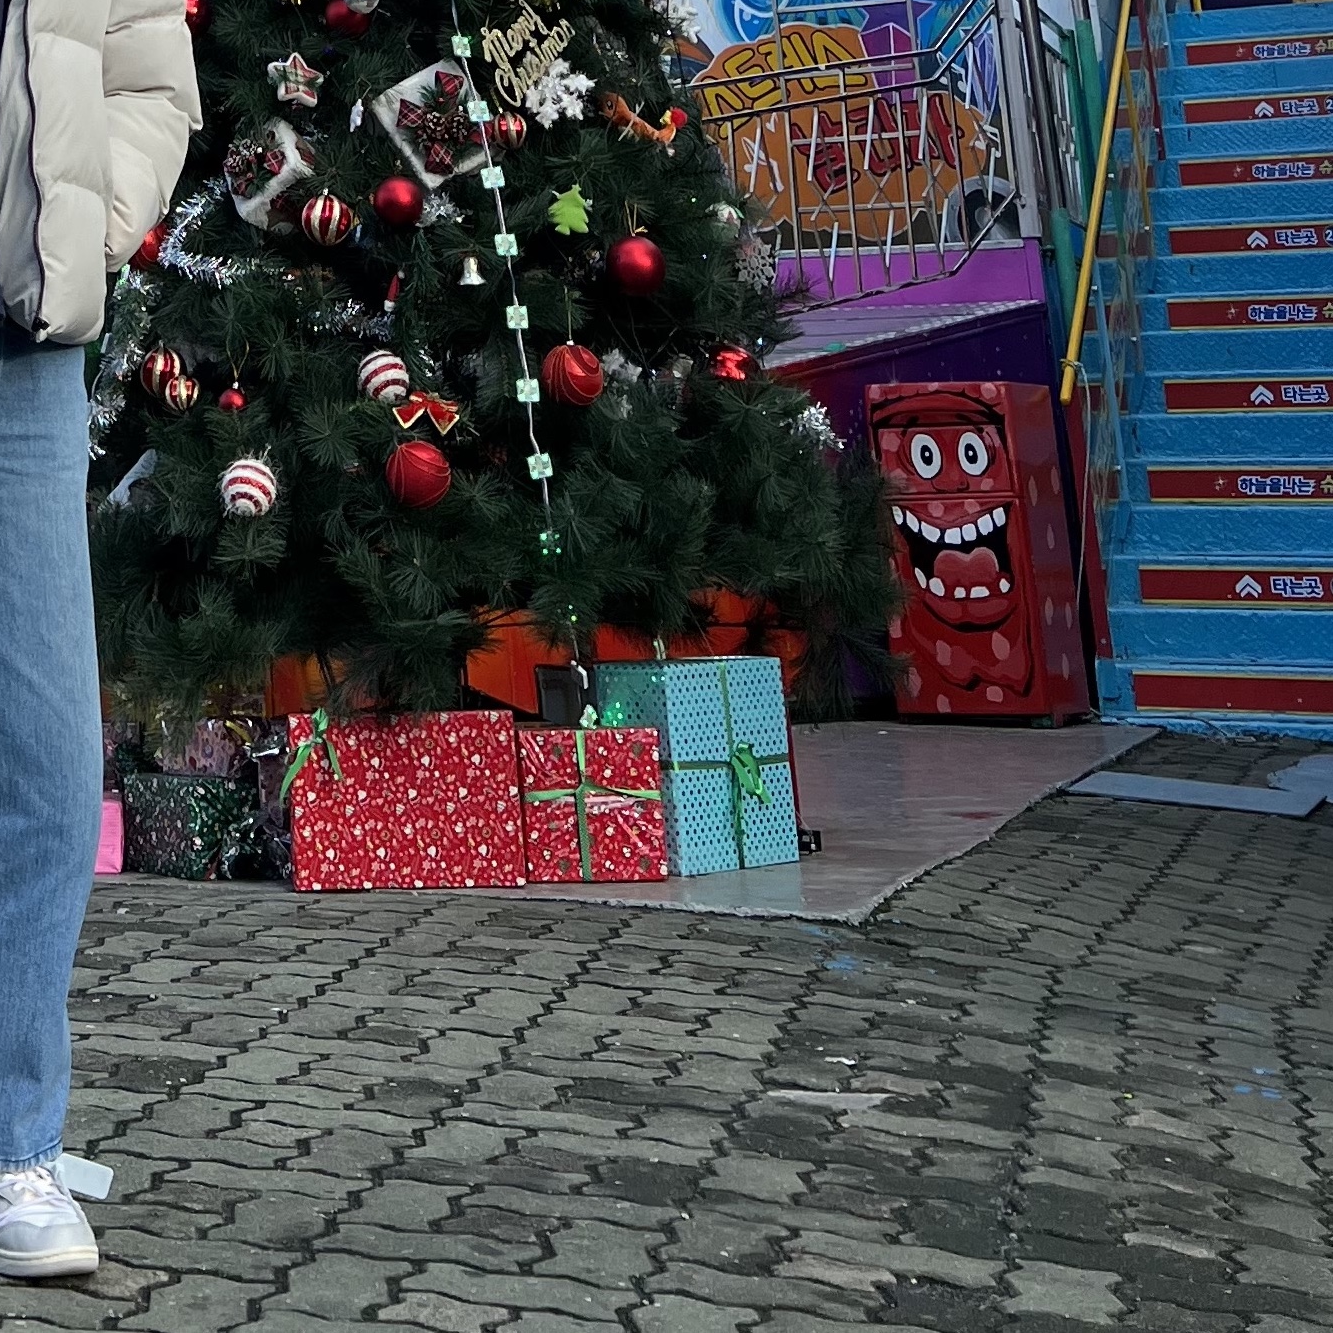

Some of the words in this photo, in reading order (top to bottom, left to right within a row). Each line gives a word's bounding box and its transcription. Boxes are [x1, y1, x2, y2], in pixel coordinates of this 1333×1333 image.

[480, 0, 550, 71] Merry
[1279, 98, 1319, 115] 타는곳
[1252, 162, 1316, 179] 하늘을나는
[1274, 228, 1318, 246] 타는곳
[1248, 303, 1318, 322] 하늘을나는
[1280, 384, 1330, 404] 타는곳
[1237, 476, 1316, 495] 하늘을나는
[1270, 576, 1324, 598] 타는곳
